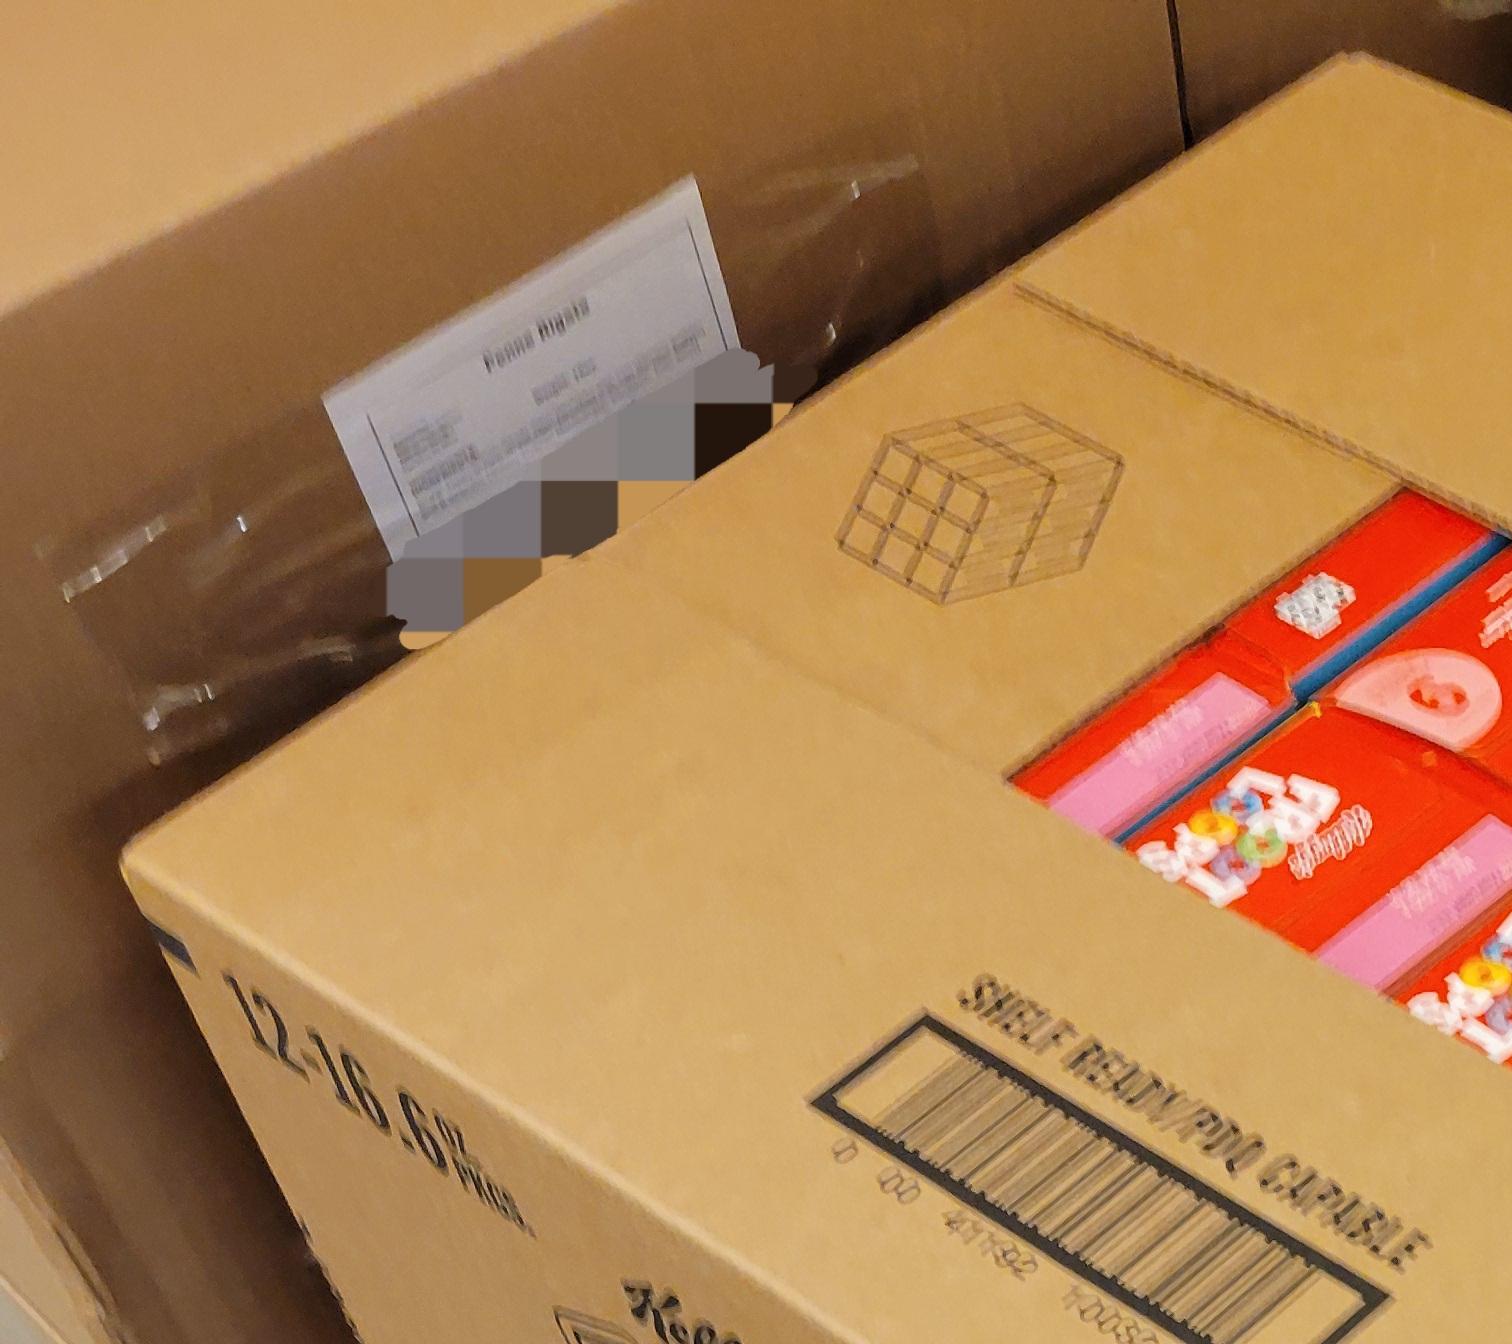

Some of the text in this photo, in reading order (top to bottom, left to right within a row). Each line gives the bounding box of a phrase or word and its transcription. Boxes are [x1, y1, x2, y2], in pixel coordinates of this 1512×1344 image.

[220, 968, 450, 1178] 12-16.6
[955, 972, 1434, 1274] SHELF READY/PDQ CAPABLE
